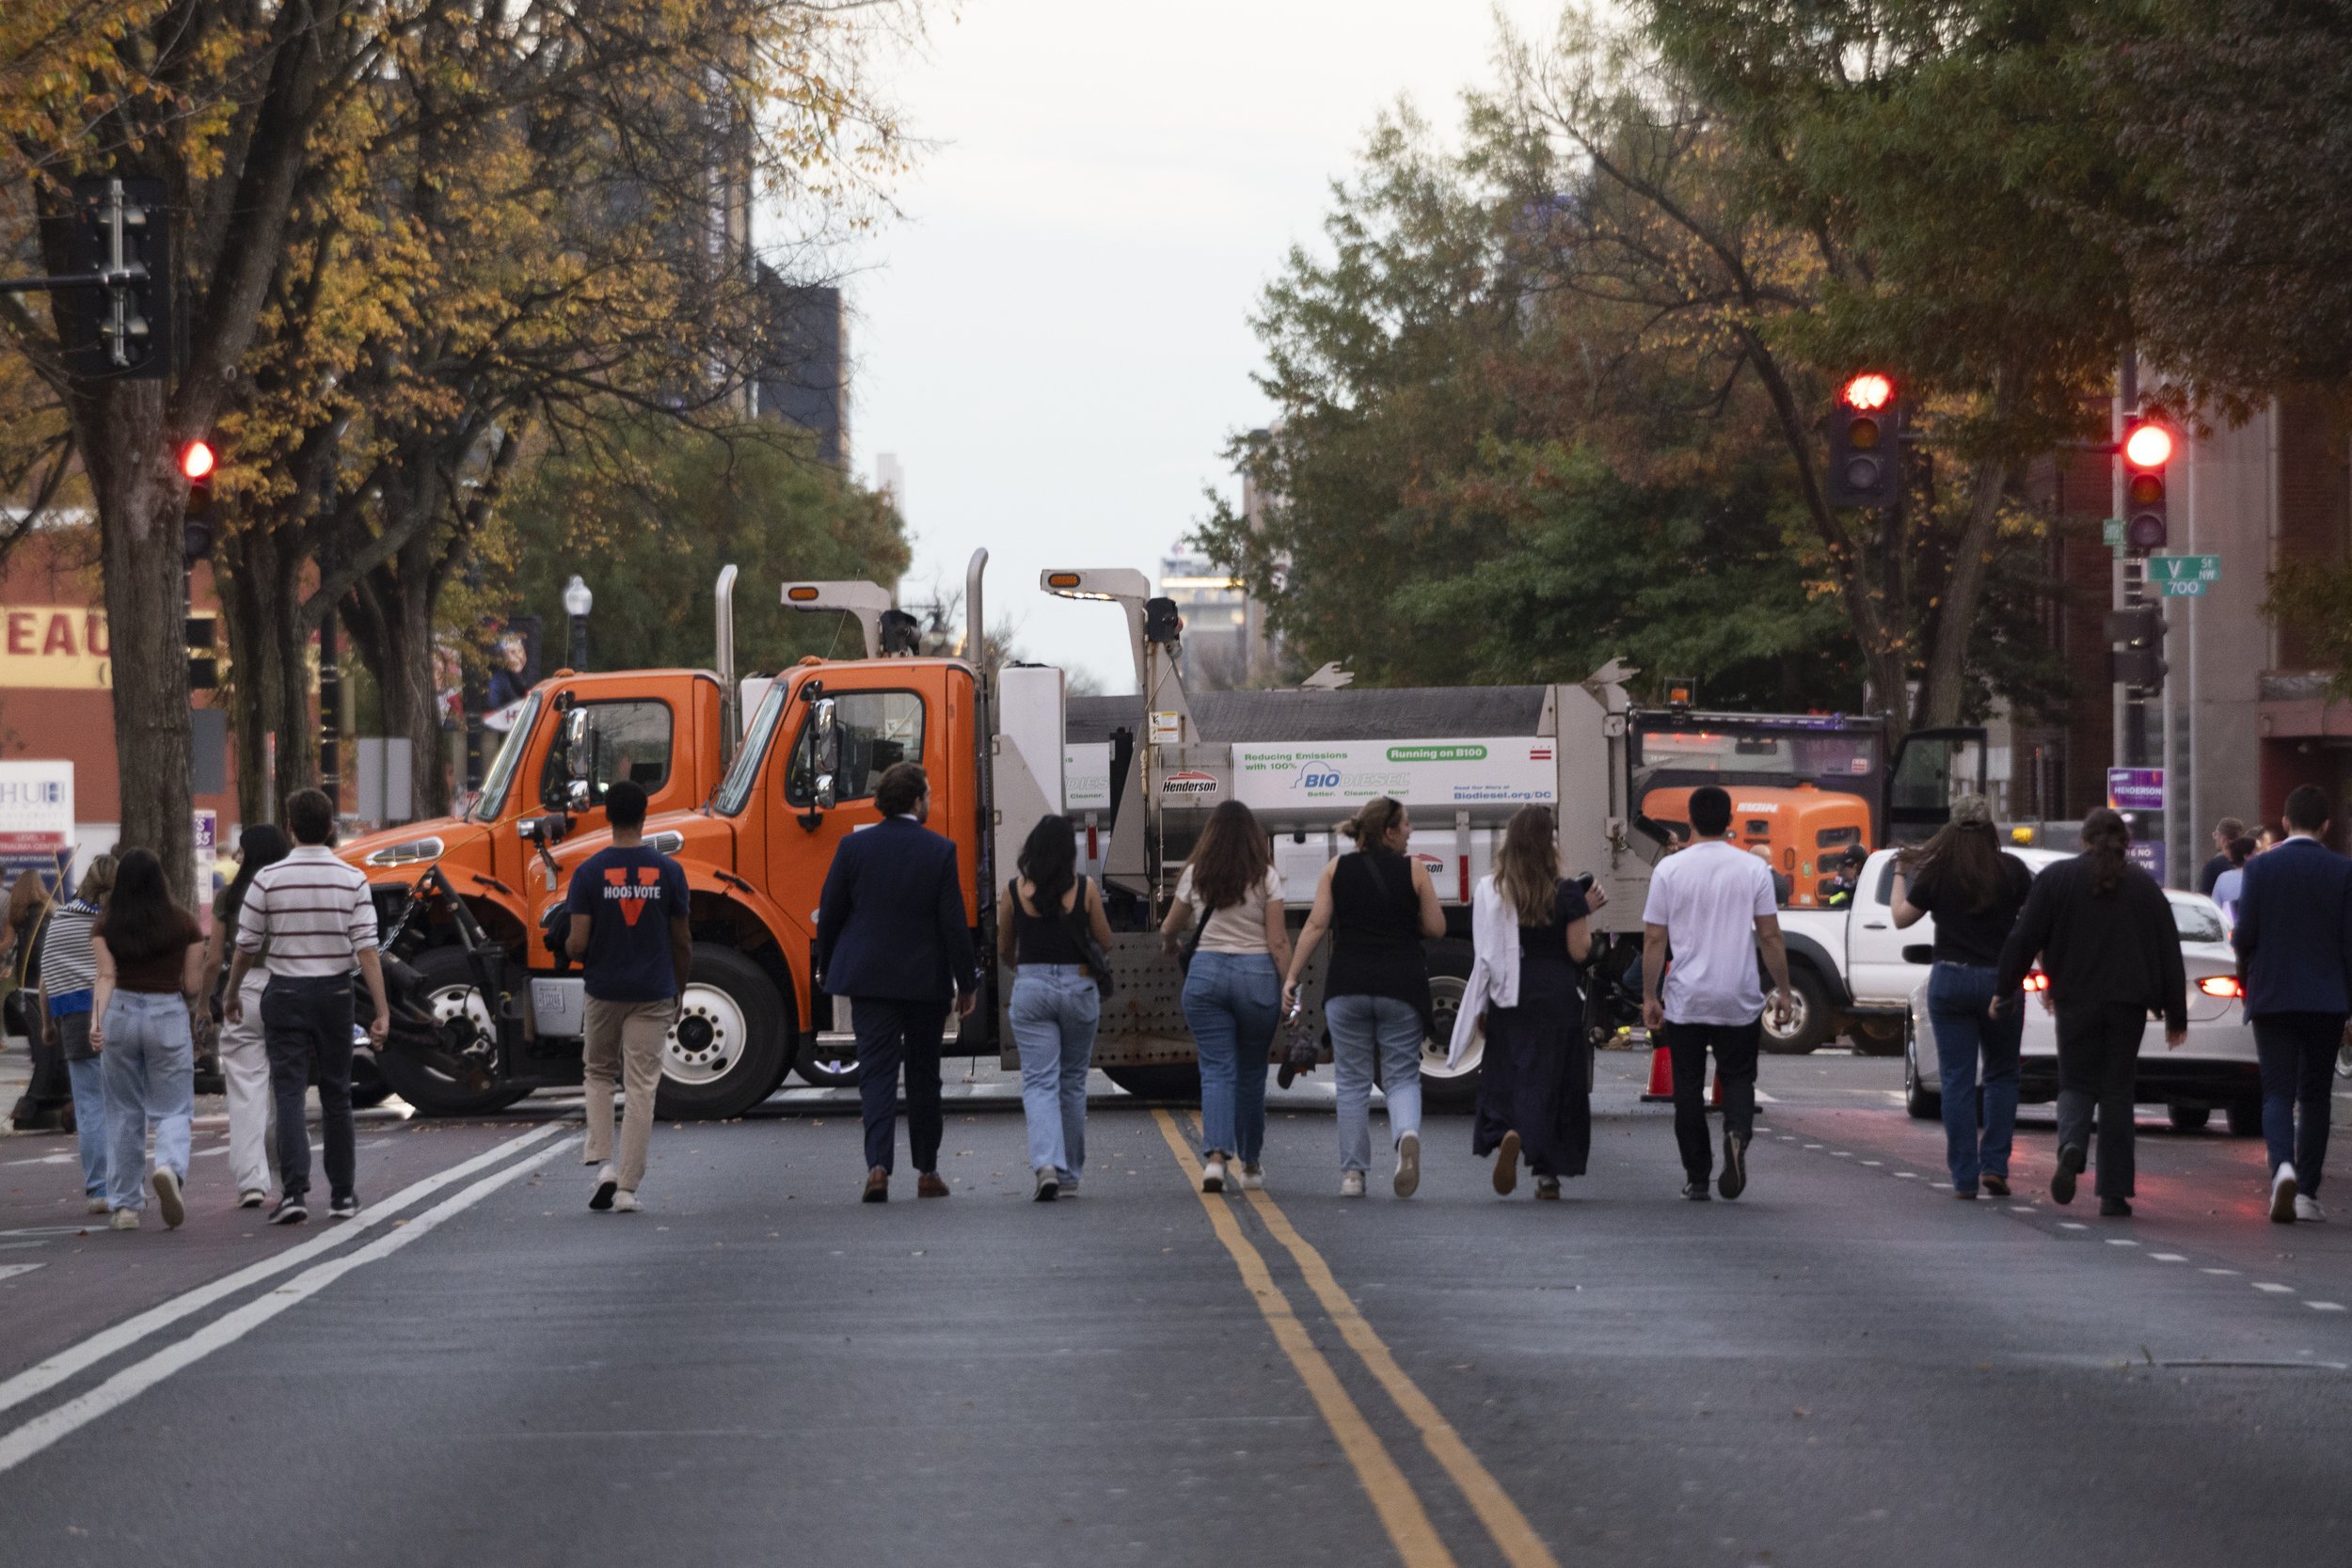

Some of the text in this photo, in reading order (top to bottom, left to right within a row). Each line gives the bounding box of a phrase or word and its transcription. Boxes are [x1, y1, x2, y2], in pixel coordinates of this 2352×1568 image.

[2201, 557, 2212, 568] St
[2168, 560, 2181, 578] V
[2199, 570, 2215, 579] NW
[2168, 581, 2199, 594] 700
[1391, 749, 1438, 759] Running
[1163, 782, 1216, 793] Henderson
[2114, 786, 2162, 795] HENDERSON
[1454, 791, 1552, 800] Biodiesel.org/DC
[604, 886, 660, 899] HOOS VOTE
